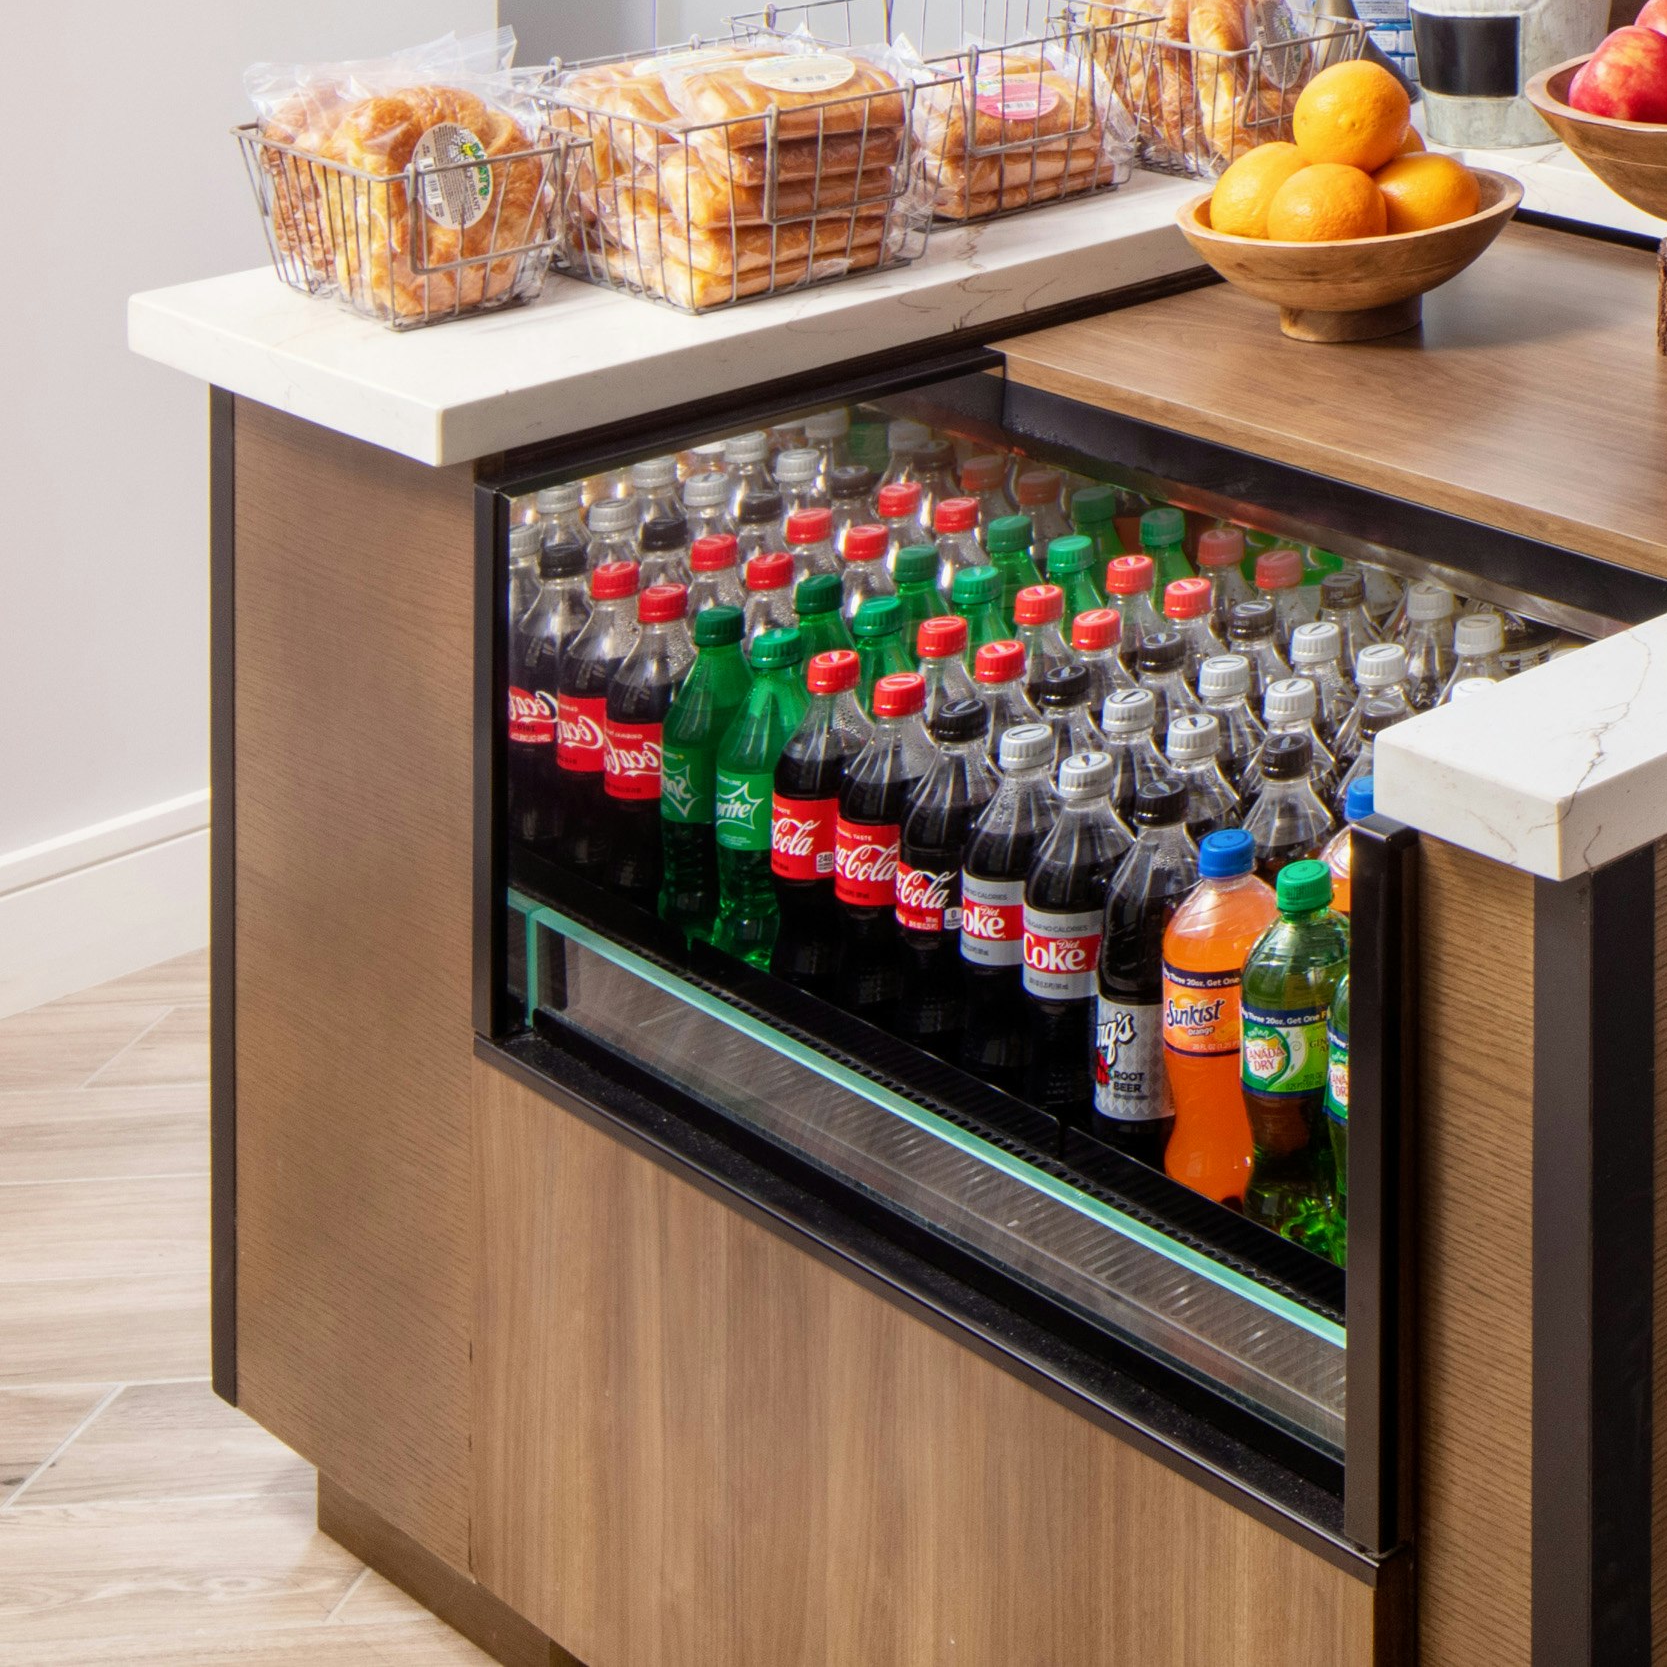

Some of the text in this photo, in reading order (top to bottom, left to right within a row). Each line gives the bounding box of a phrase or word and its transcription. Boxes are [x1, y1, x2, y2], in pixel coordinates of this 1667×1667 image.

[818, 854, 833, 863] 240
[978, 905, 999, 916] Diet
[1057, 939, 1080, 949] Diet
[1024, 933, 1086, 970] Coke
[1167, 999, 1225, 1026] Sunkist
[1187, 1027, 1214, 1036] Orange
[1254, 1059, 1275, 1071] DRY
[1113, 1071, 1145, 1080] ROOT
[1113, 1083, 1142, 1093] BEER
